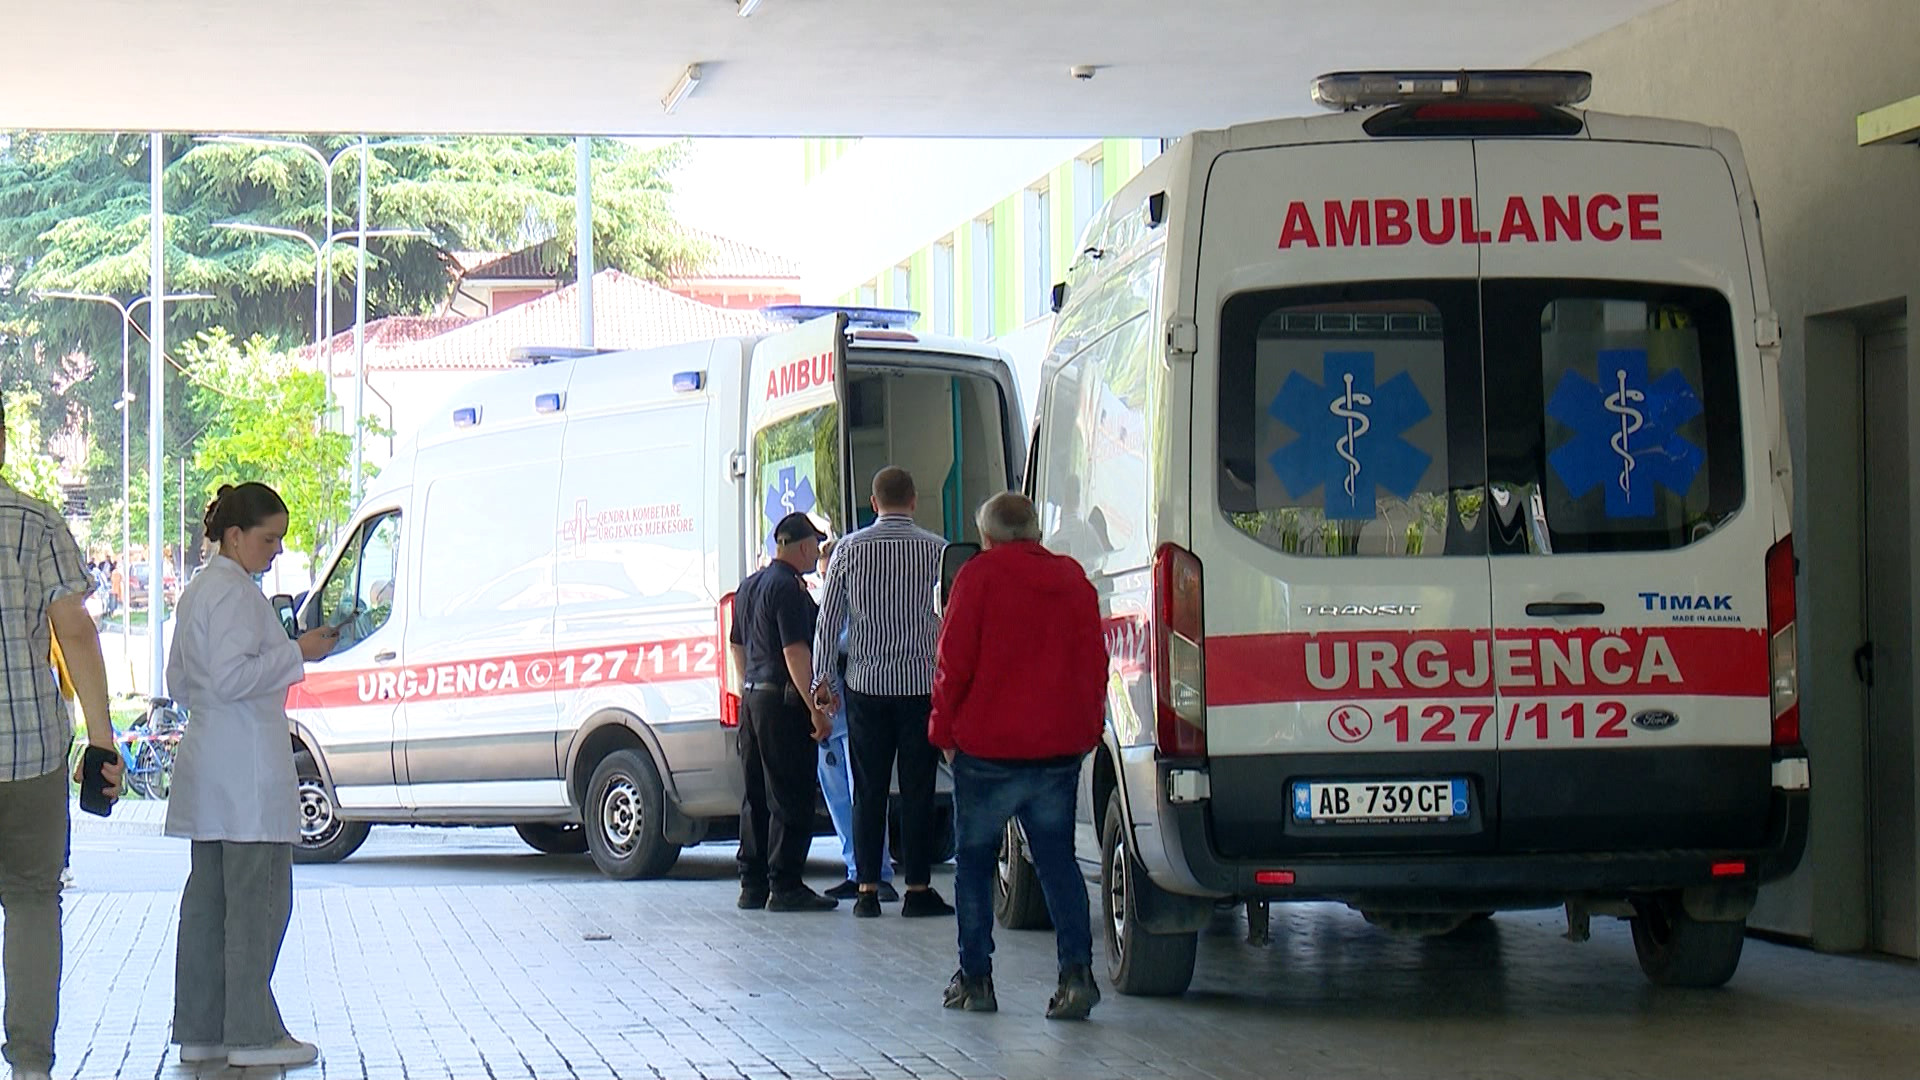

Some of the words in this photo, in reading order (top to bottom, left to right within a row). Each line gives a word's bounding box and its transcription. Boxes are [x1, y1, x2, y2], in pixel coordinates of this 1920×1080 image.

[1277, 194, 1662, 249] AMBULANCE
[1300, 602, 1422, 616] TRANSIT
[1707, 615, 1741, 623] ALBANIA
[357, 660, 520, 701] URGJENCA
[558, 641, 716, 685] 127/112
[1304, 636, 1684, 690] URGJENCA
[1383, 701, 1629, 742] 127/112
[1319, 787, 1350, 815] AB
[1366, 785, 1414, 814] 739
[1418, 784, 1449, 813] CF
